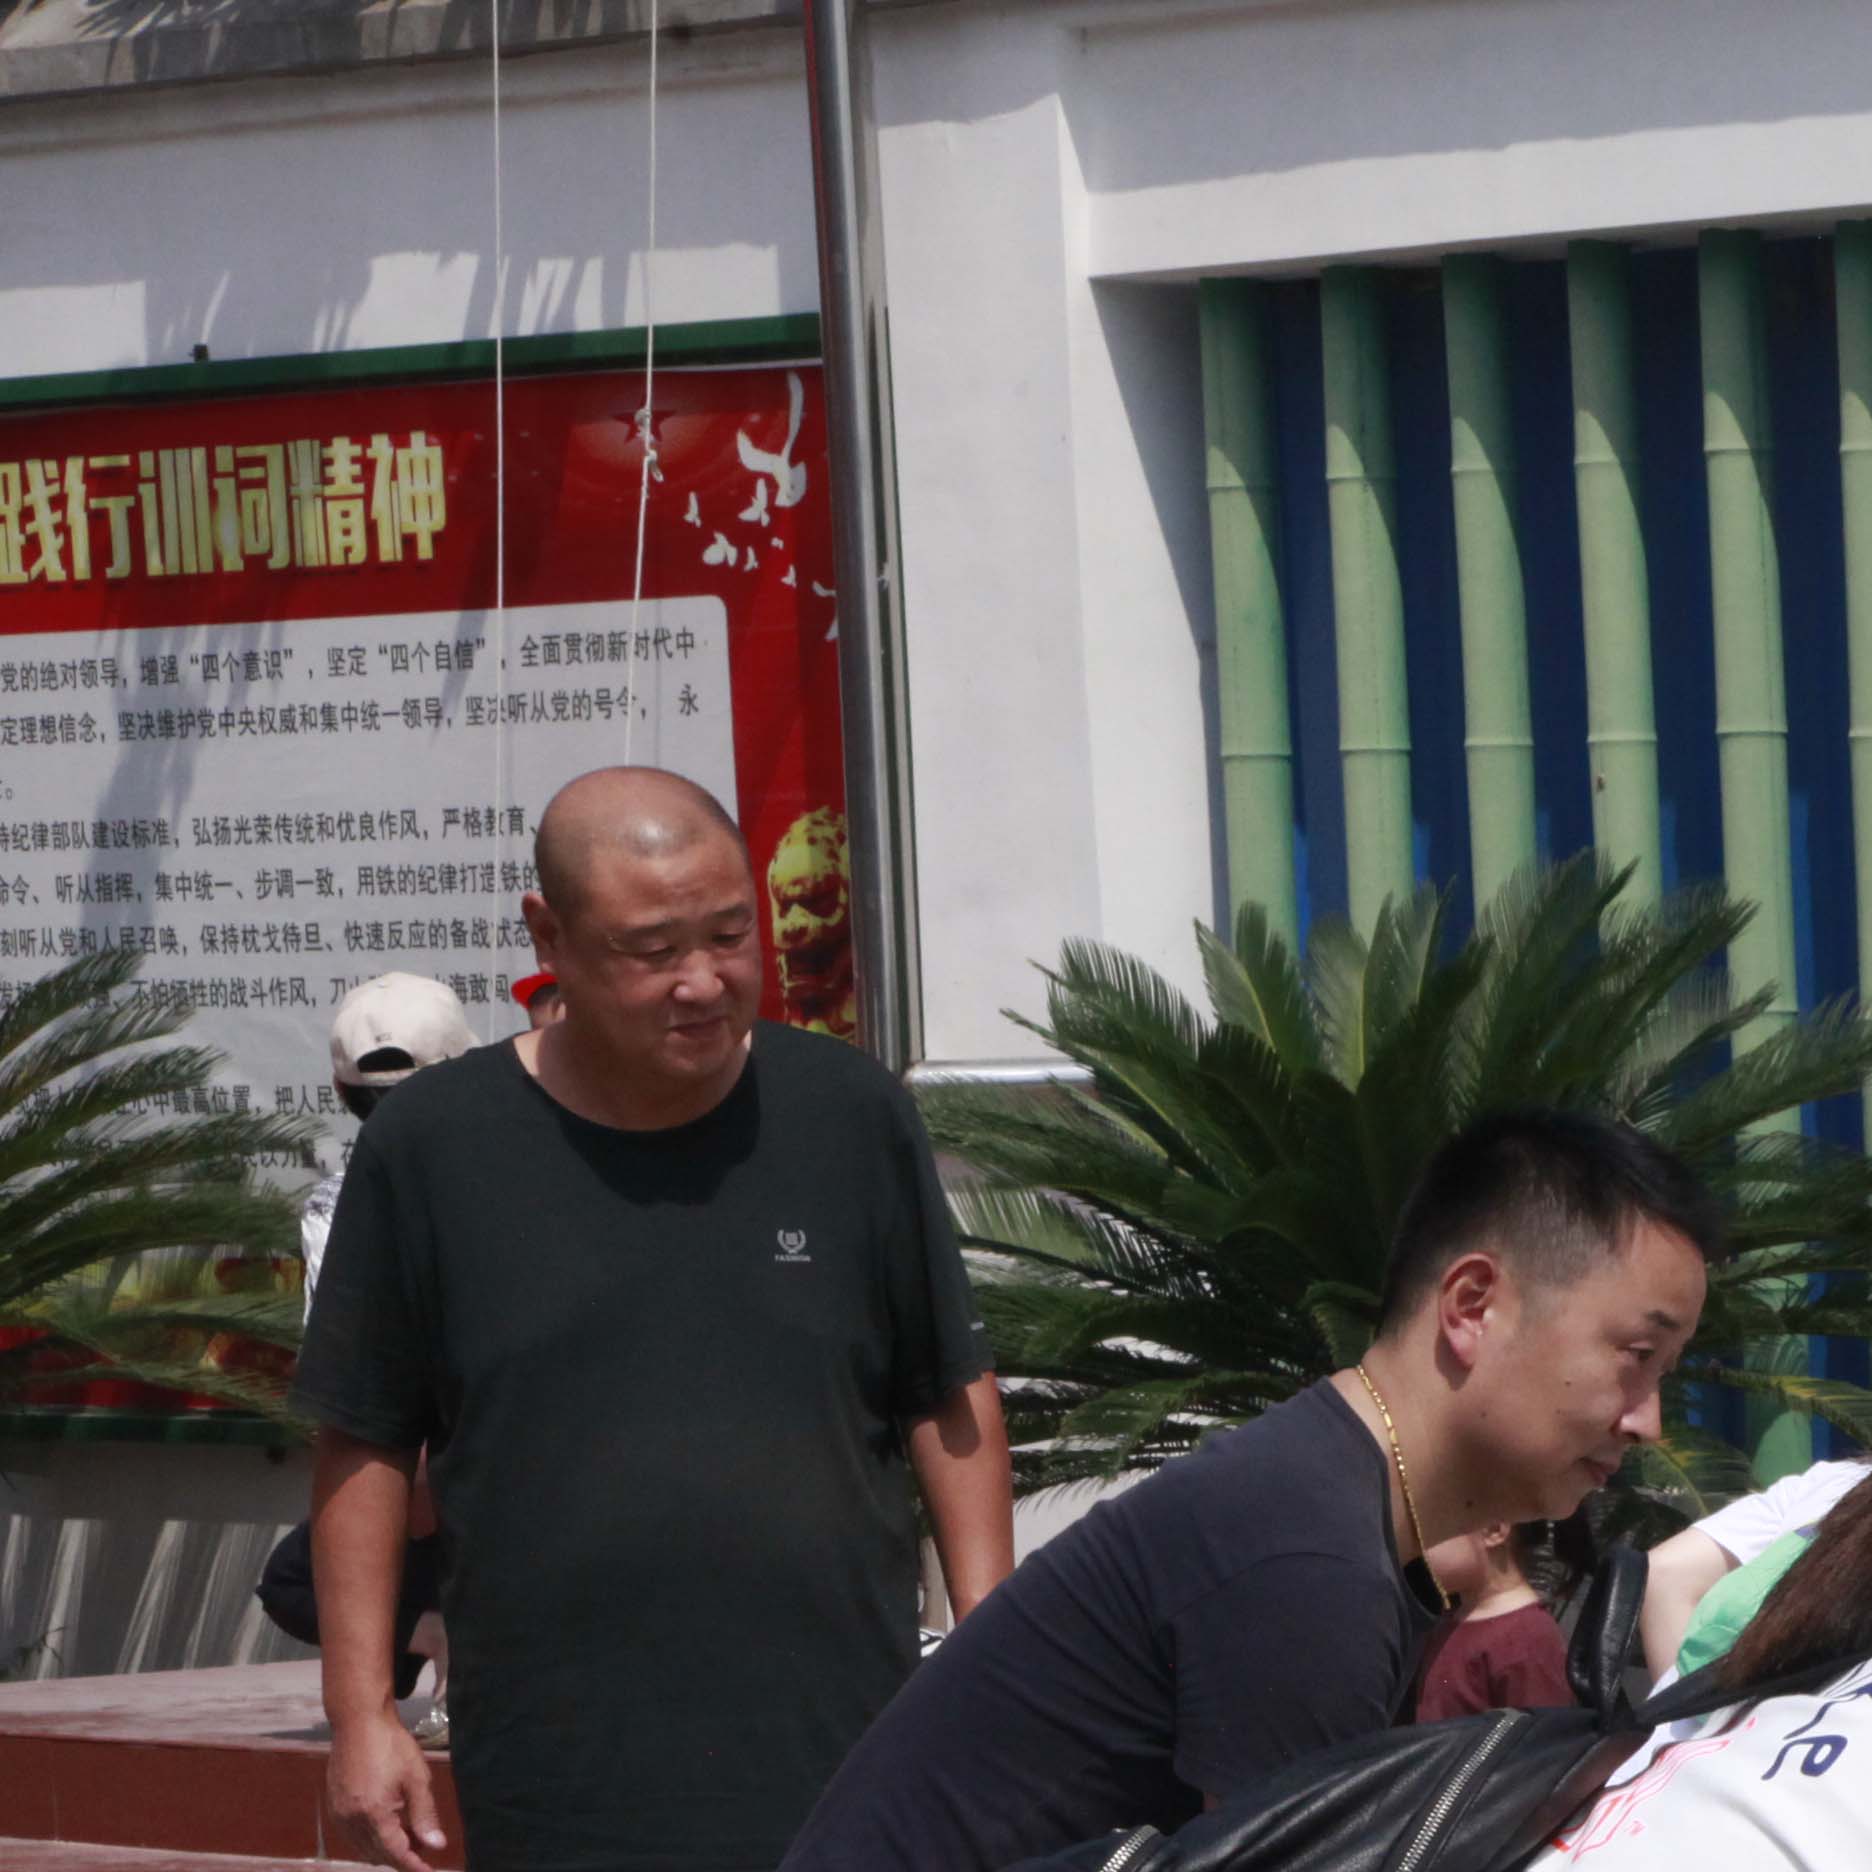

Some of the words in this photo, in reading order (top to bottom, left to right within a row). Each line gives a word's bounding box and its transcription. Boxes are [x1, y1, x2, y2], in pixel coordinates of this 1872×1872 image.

[0, 430, 447, 585] 践行训词精神
